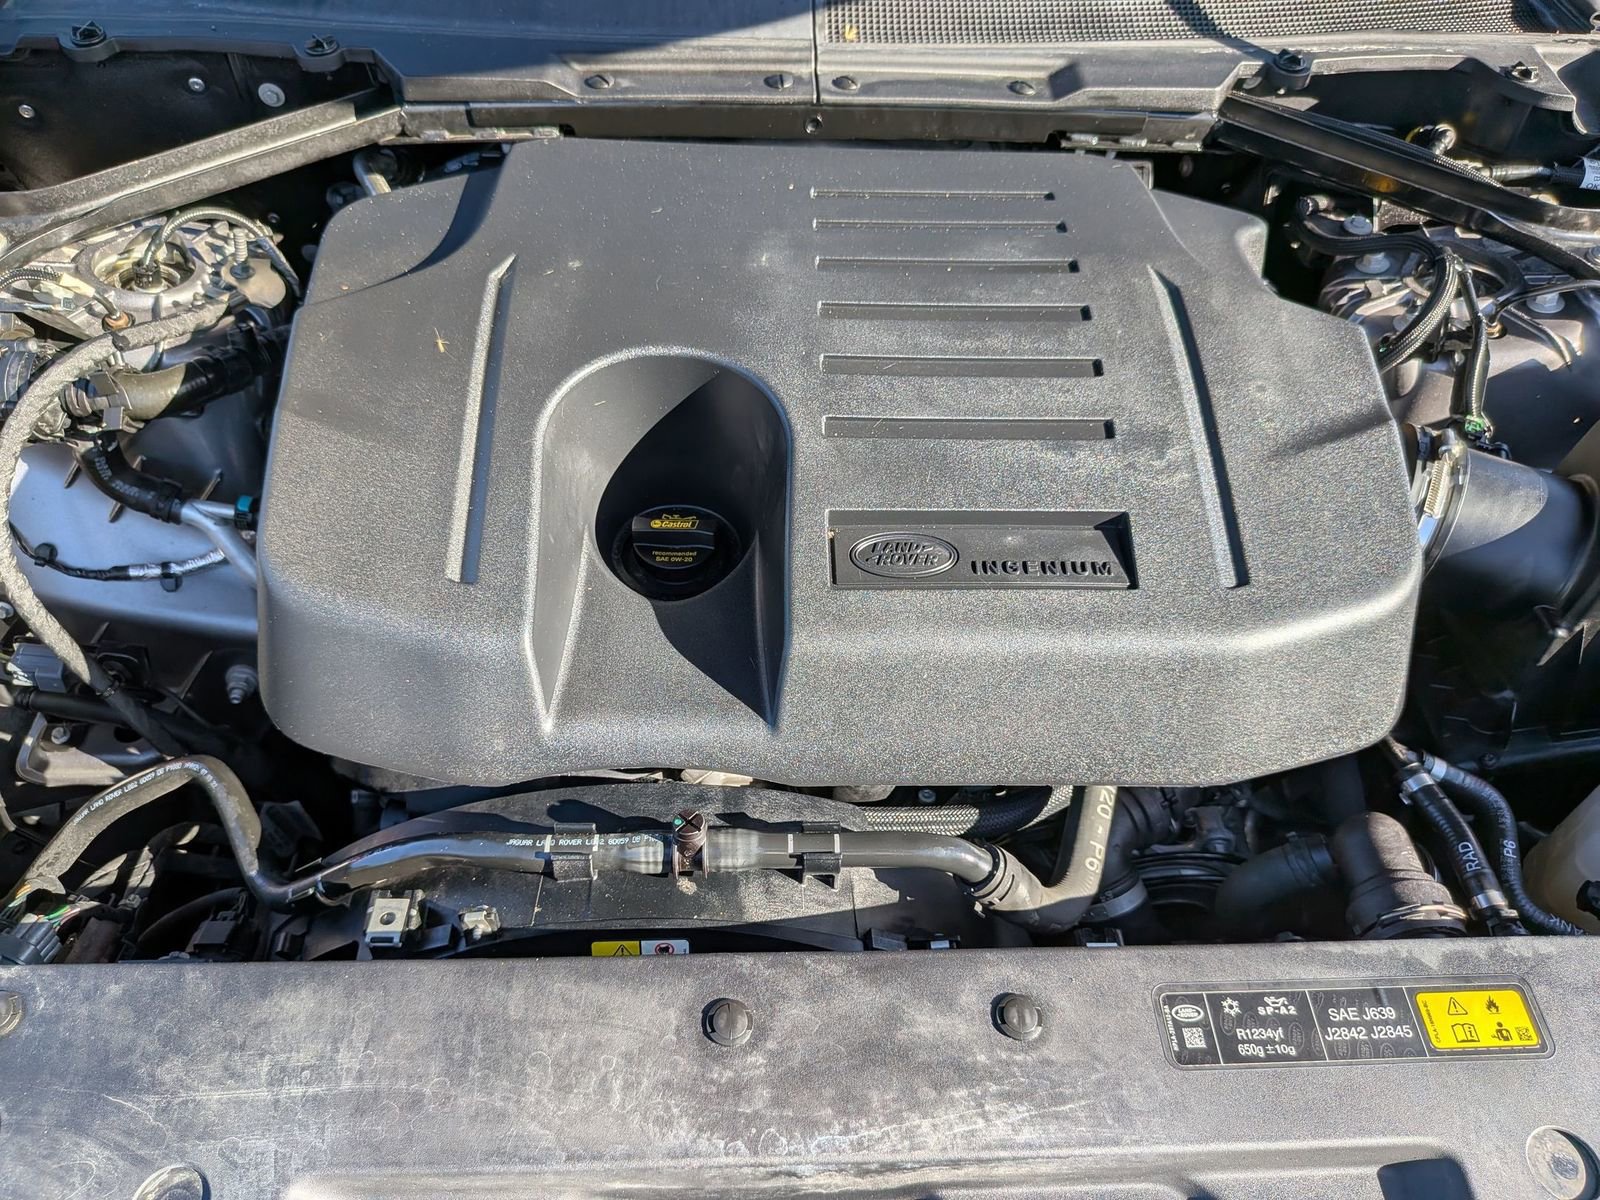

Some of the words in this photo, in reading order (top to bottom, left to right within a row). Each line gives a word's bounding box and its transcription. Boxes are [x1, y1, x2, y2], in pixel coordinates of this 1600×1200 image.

[661, 520, 692, 528] Castrol
[875, 554, 938, 566] ROVER
[970, 560, 1113, 576] INGENIUM
[506, 839, 533, 847] JAGUAR
[536, 839, 555, 847] LAD
[1458, 842, 1482, 872] RAD
[1257, 1006, 1298, 1016] SP-A2
[1328, 1008, 1360, 1021] SAE
[1363, 1007, 1396, 1020] J639
[1236, 1027, 1285, 1041] R1234yf
[1325, 1027, 1368, 1040] J2842
[1370, 1025, 1413, 1038] J2845
[1237, 1044, 1265, 1057] 650g
